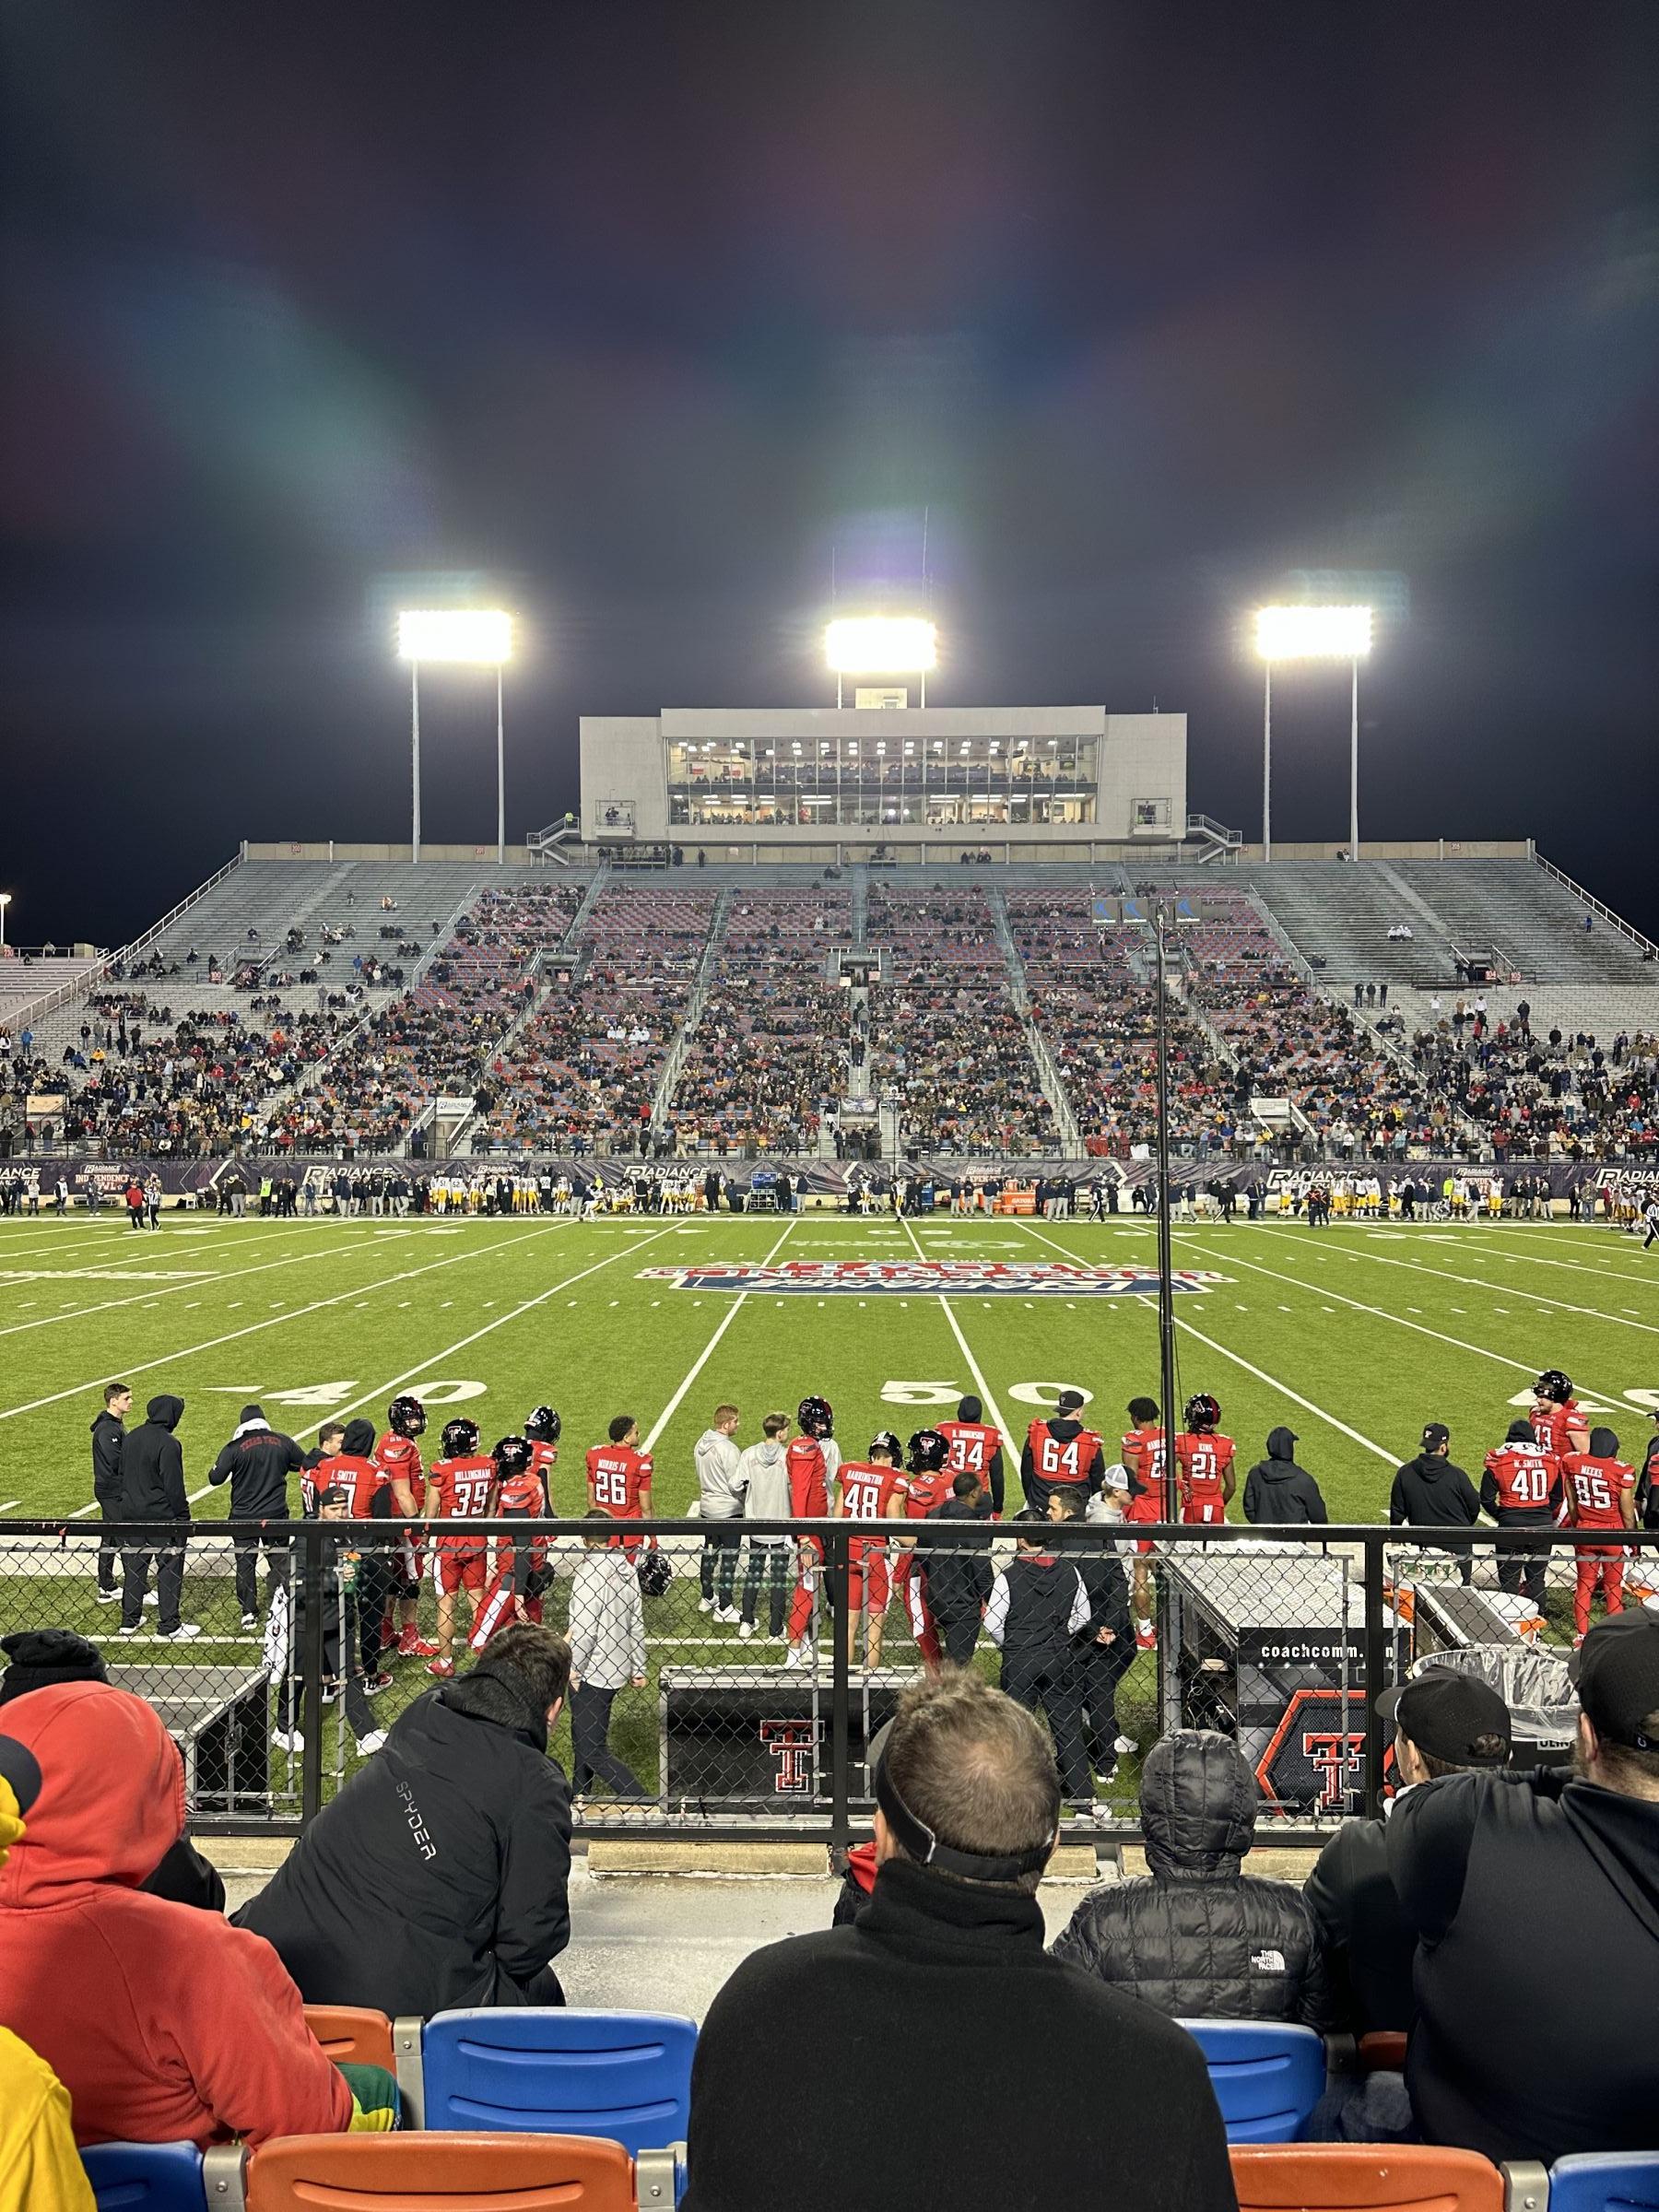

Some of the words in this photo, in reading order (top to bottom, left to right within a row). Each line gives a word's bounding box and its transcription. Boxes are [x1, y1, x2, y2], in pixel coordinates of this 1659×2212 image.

[624, 1165, 710, 1180] RADIANCE
[1266, 1169, 1357, 1189] RADIANCE
[951, 1439, 983, 1471] 34
[1042, 1438, 1079, 1475] 64
[1191, 1453, 1217, 1479] 21
[1521, 1458, 1544, 1468] SMITH
[336, 1470, 359, 1482] SMITH
[595, 1470, 627, 1505] 26
[1511, 1468, 1548, 1501] 40
[1574, 1475, 1612, 1510] 85
[451, 1481, 489, 1517] 39
[844, 1483, 880, 1519] 48
[395, 1781, 437, 1861] SPYDER
